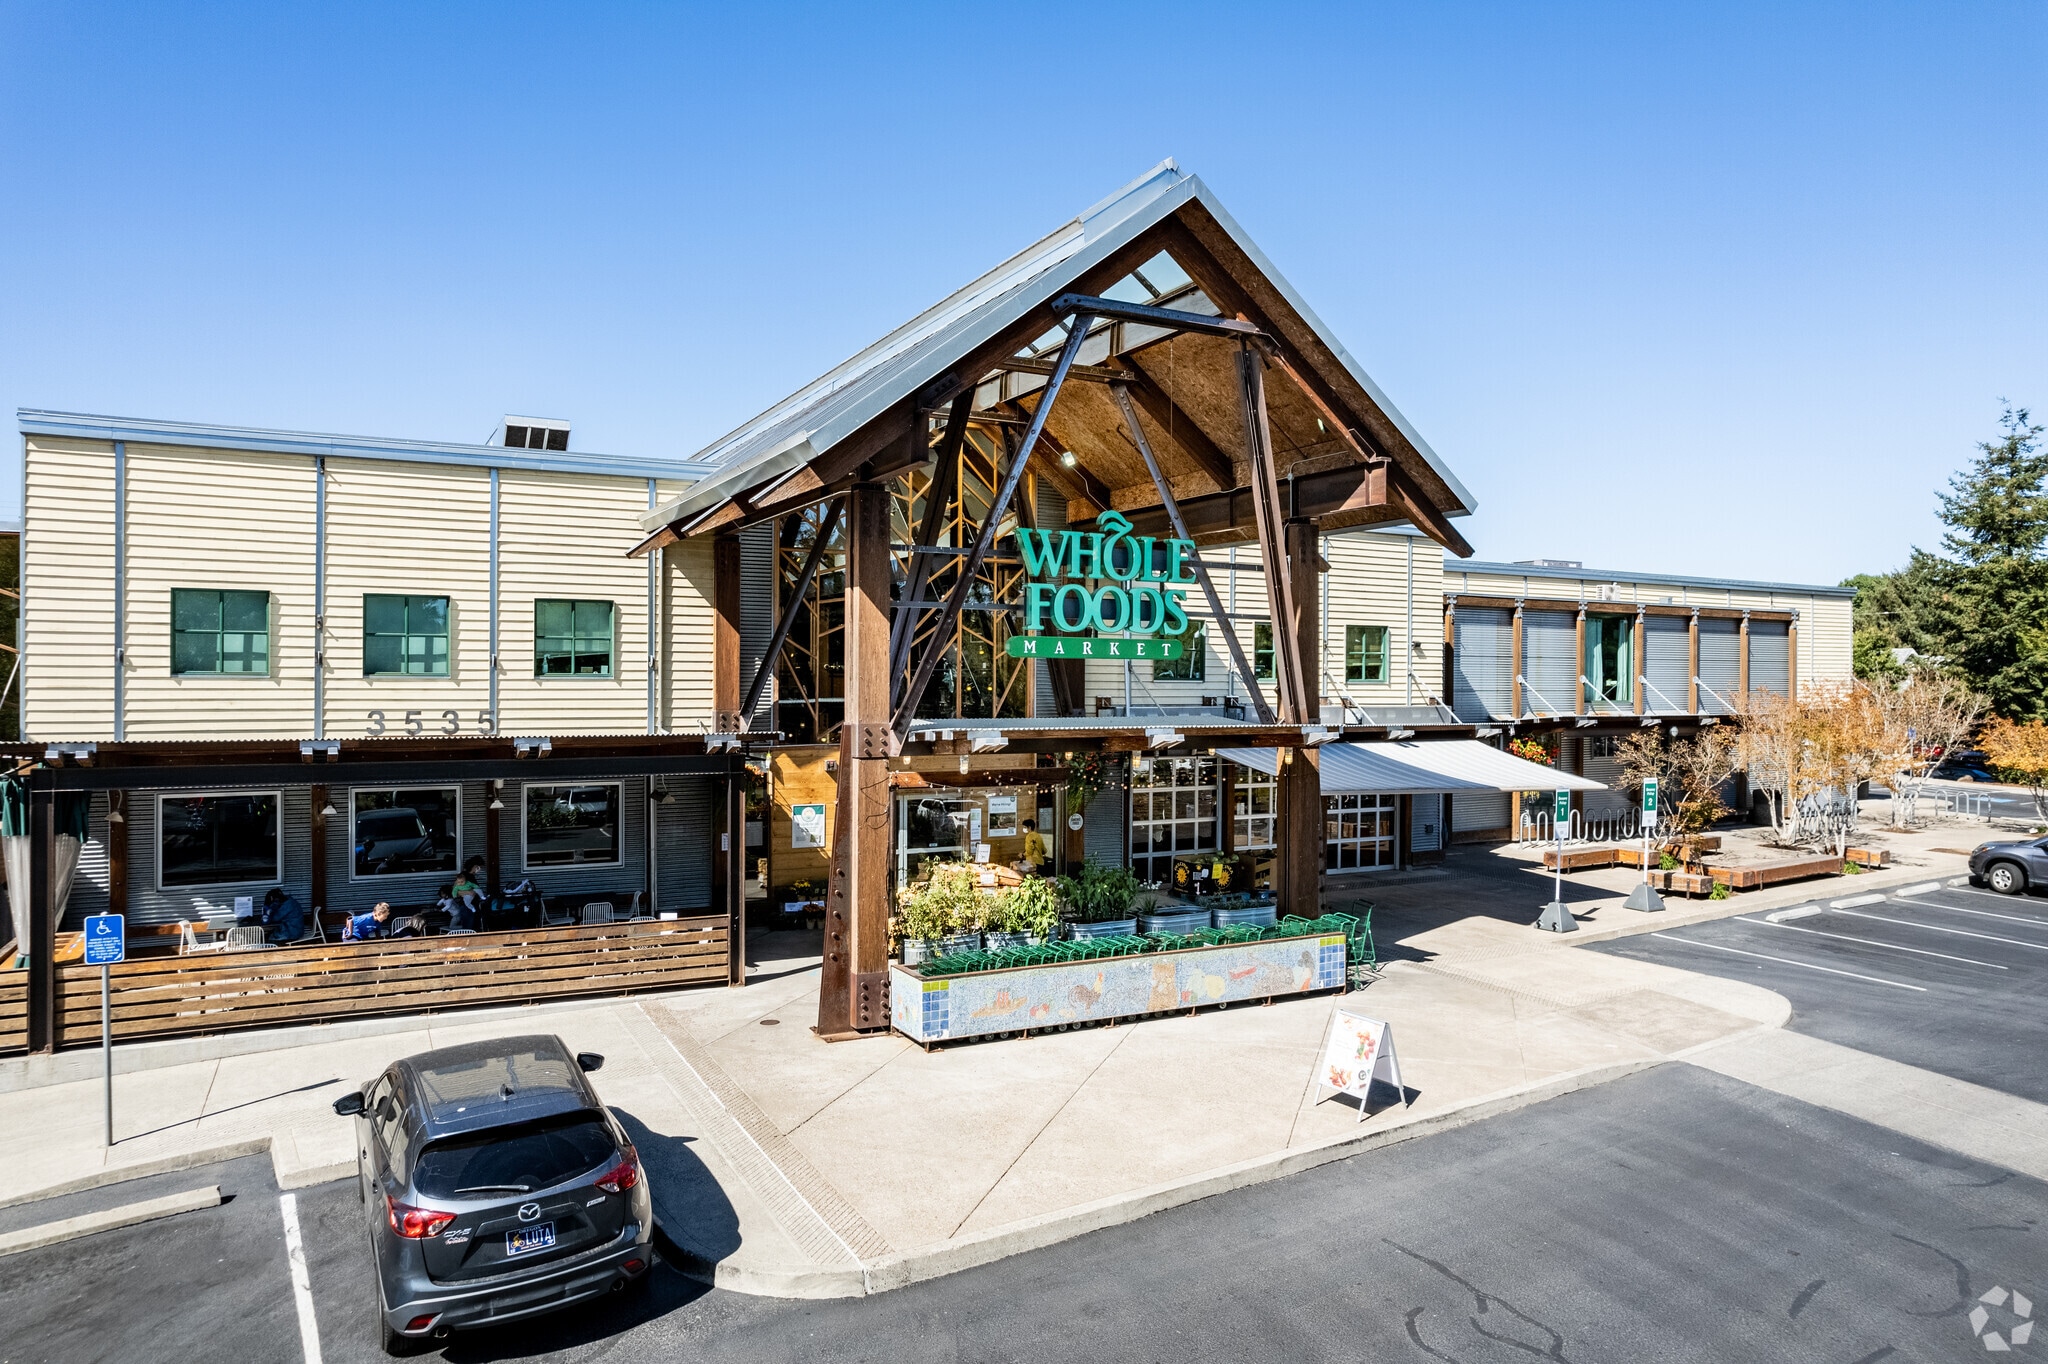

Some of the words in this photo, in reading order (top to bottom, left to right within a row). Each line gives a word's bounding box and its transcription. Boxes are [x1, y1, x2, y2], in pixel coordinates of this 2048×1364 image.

[1015, 510, 1197, 584] WHOLE
[1024, 582, 1188, 636] FOODS
[1023, 640, 1171, 657] MARKET
[366, 710, 496, 736] 3535
[1647, 797, 1653, 806] 2
[1560, 807, 1565, 817] 1
[525, 1227, 552, 1246] LUTA
